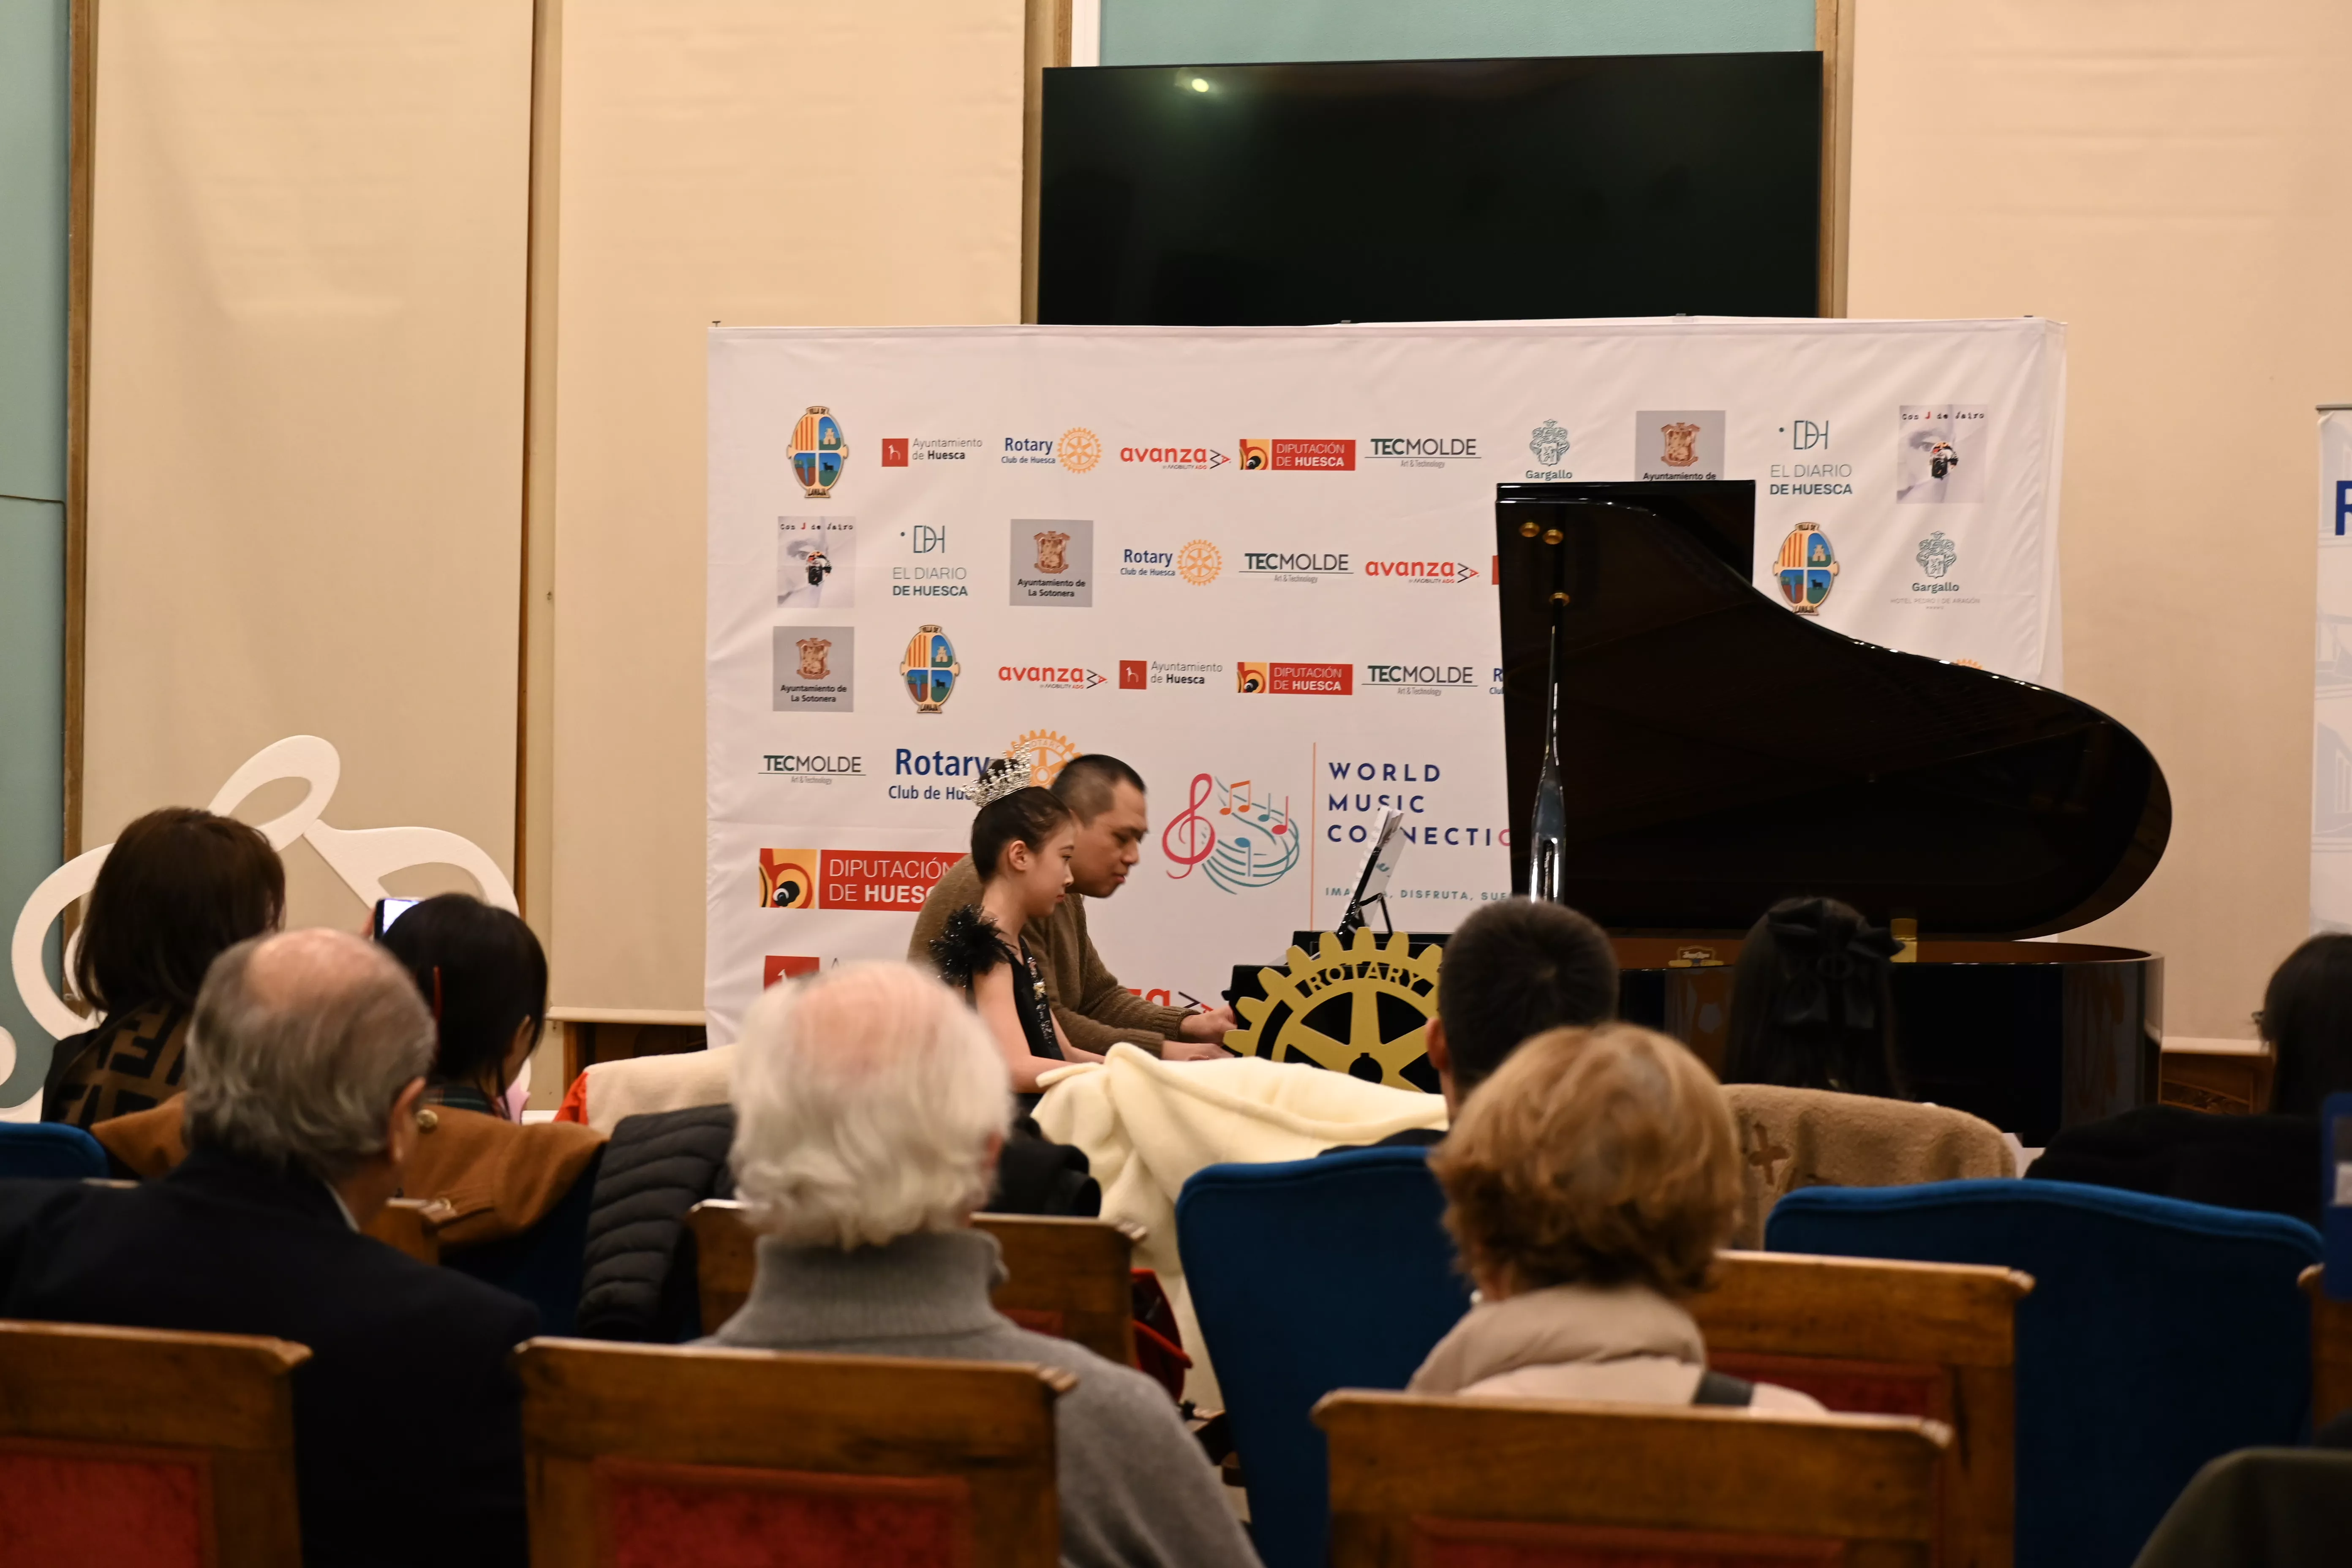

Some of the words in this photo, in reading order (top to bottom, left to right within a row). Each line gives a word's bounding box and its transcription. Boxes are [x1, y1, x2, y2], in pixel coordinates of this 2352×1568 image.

[1925, 411, 1930, 419] J
[912, 438, 983, 448] Ayuntamiento
[1005, 438, 1053, 455] Rotary
[1277, 442, 1345, 454] DIPUTACIÓN
[1371, 438, 1476, 455] TECMOLDE
[912, 451, 924, 460] de
[928, 451, 965, 460] Huesca
[1120, 447, 1206, 463] avanza
[1277, 457, 1291, 466] DE
[1295, 457, 1345, 466] HUESCA
[1415, 460, 1445, 468] Technology
[1526, 470, 1572, 480] Gargallo
[1770, 465, 1787, 477] EL
[1794, 464, 1852, 477] DIARIO
[1643, 472, 1704, 481] Ayuntamiento
[1706, 472, 1716, 480] de
[1770, 484, 1789, 495] DE
[1793, 484, 1853, 495] HUESCA
[1124, 549, 1173, 567] Rotary
[1244, 553, 1349, 571] TECMOLDE
[893, 568, 910, 580] EL
[915, 567, 966, 580] DIARIO
[1365, 561, 1454, 576] avanza
[1018, 579, 1074, 588] Ayuntamiento
[1288, 575, 1318, 583] Technology
[893, 586, 910, 596] DE
[913, 586, 968, 596] HUESCA
[1912, 583, 1959, 593] Gargallo
[1151, 662, 1222, 673] Ayuntamiento
[1274, 666, 1342, 678] DIPUTACIÓN
[998, 666, 1084, 682] avanza
[1151, 674, 1163, 683] de
[1166, 674, 1205, 684] Huesca
[1367, 665, 1473, 683] TECMOLDE
[781, 685, 836, 693] Ayuntamiento
[1274, 680, 1288, 690] DE
[1292, 681, 1341, 691] HUESCA
[1412, 687, 1441, 696] Technology
[1029, 739, 1060, 750] OTARY
[764, 755, 861, 773] TECMOLDE
[1328, 762, 1440, 781] WORLD
[804, 776, 832, 784] Technology
[889, 785, 918, 799] Club
[924, 786, 940, 799] de
[1328, 794, 1424, 813] MUSIC
[1328, 825, 1510, 846] CONECTIO
[829, 884, 857, 901] DE
[865, 885, 935, 903] HUES
[1401, 890, 1473, 901] DISFRUTA,
[1304, 962, 1423, 994] ROTARY
